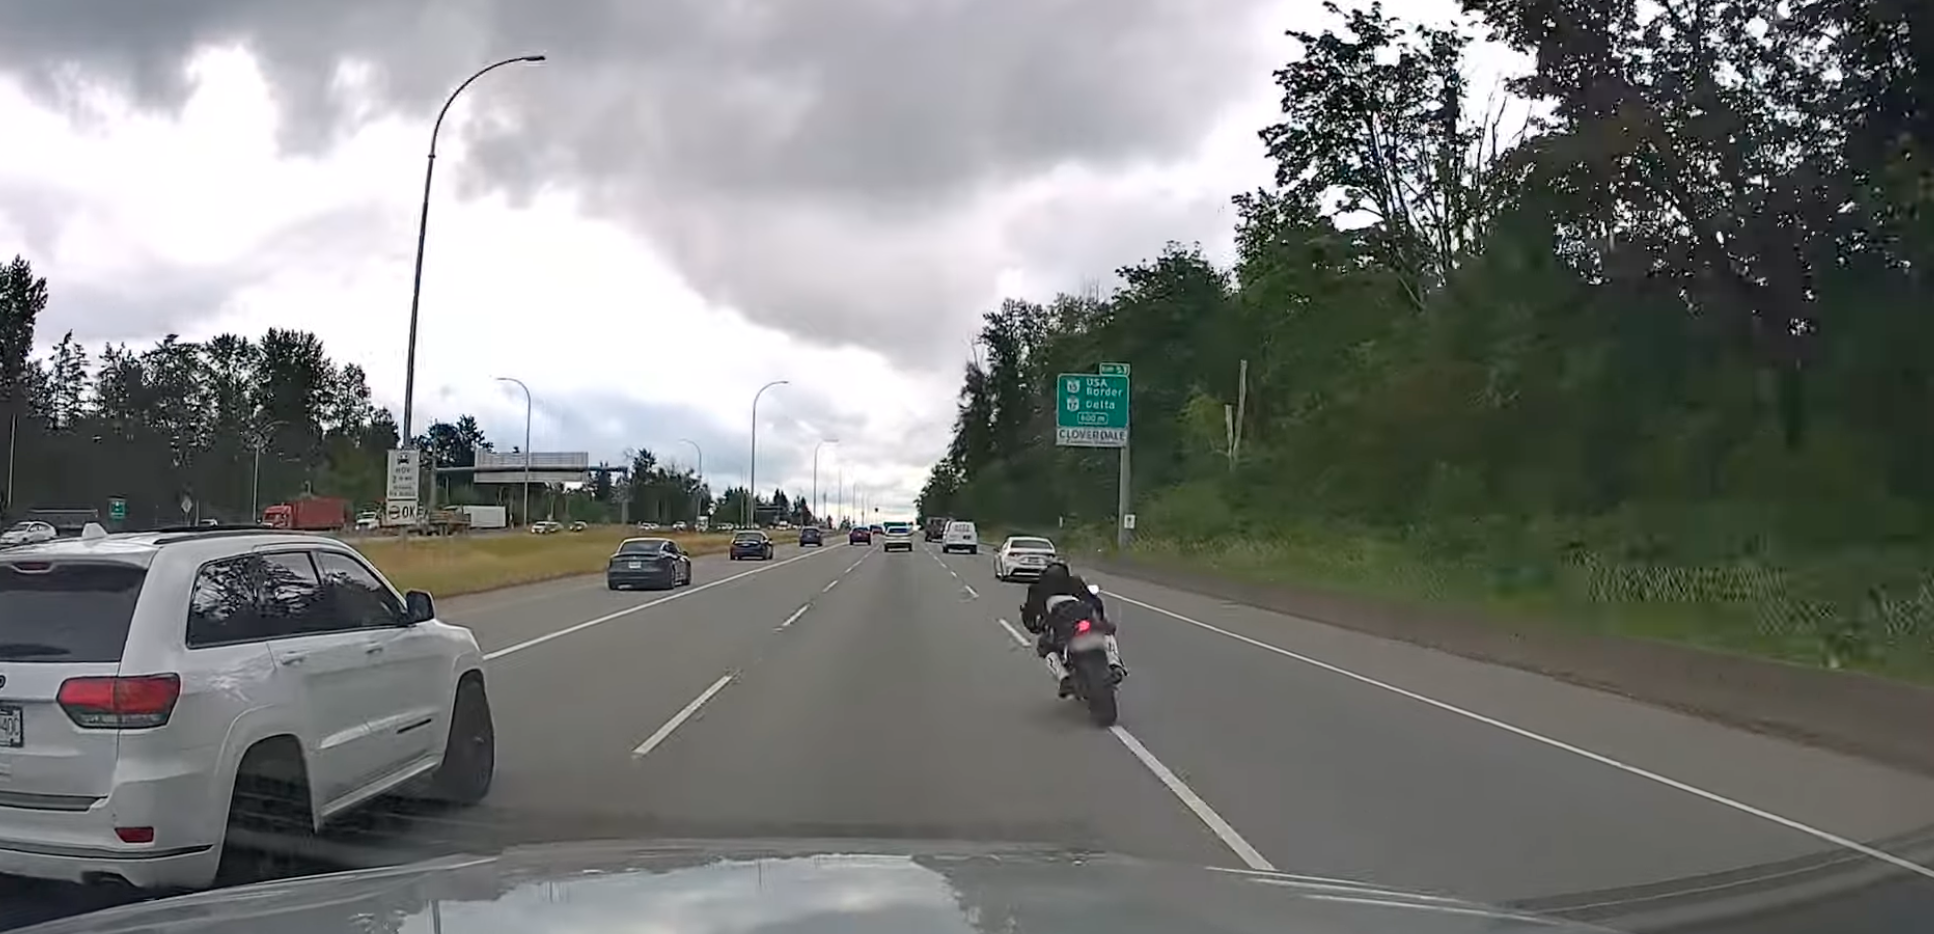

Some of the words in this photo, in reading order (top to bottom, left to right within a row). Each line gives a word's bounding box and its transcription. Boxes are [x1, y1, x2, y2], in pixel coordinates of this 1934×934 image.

[1086, 378, 1108, 388] USA
[1086, 387, 1123, 397] Border
[1086, 400, 1115, 410] Delta
[1060, 430, 1125, 440] CLOVERDALE
[402, 505, 417, 519] OK
